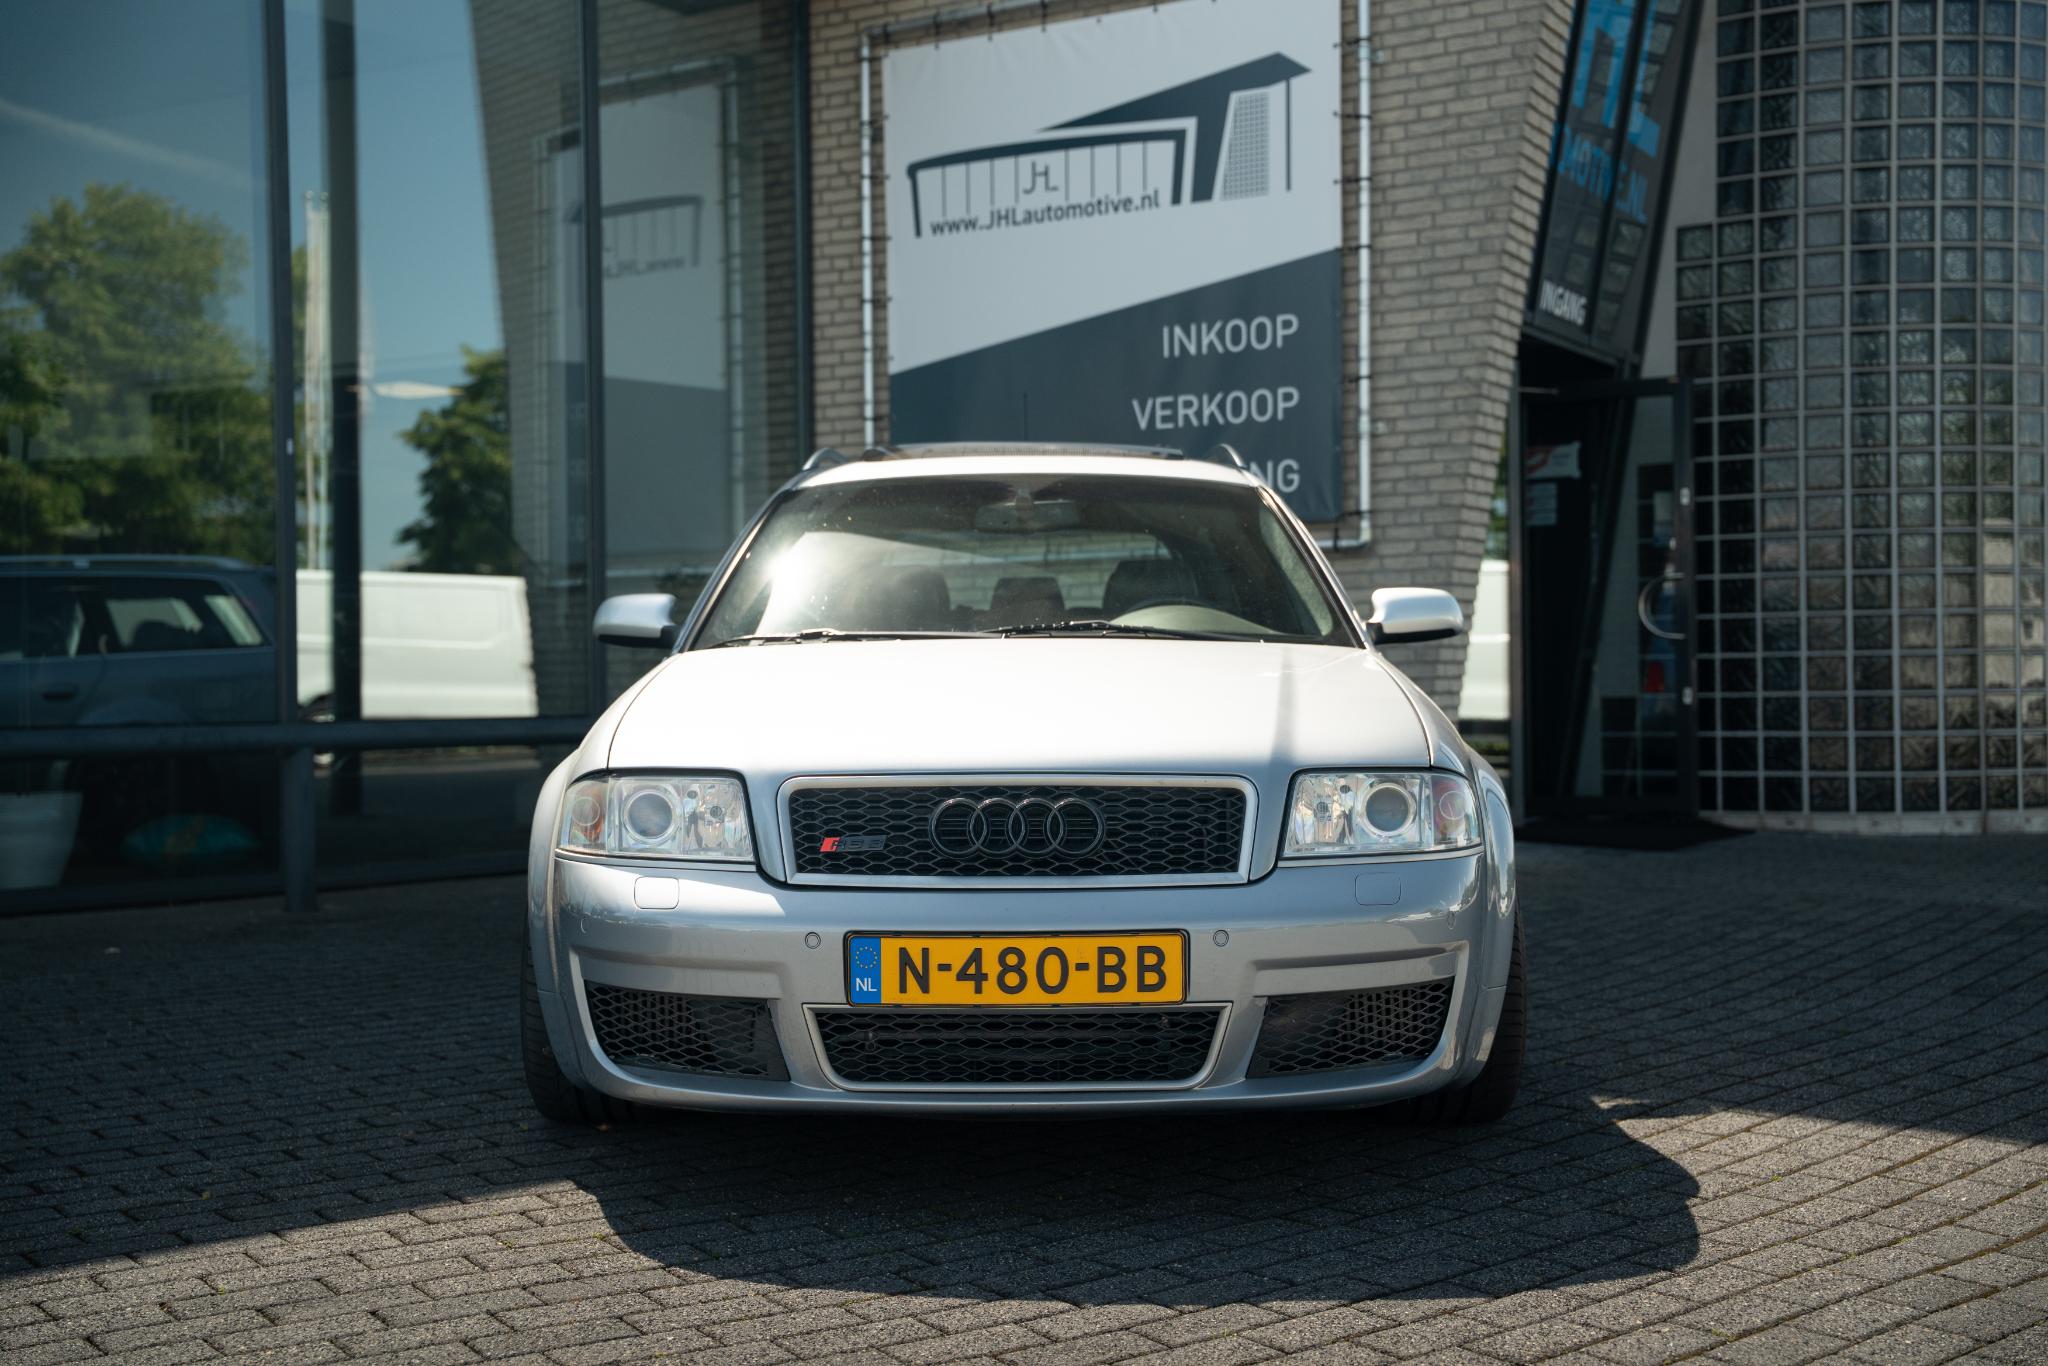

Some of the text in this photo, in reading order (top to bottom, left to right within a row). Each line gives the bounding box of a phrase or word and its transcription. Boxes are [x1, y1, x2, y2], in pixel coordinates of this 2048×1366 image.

[930, 188, 1160, 236] www.JHLautomotive.nl
[1539, 280, 1587, 325] INGANG
[1162, 313, 1299, 359] INKOOP
[1131, 386, 1300, 431] VERKOOP
[1248, 458, 1301, 494] NG
[855, 977, 877, 992] NL
[899, 946, 1167, 995] N-480-BB
